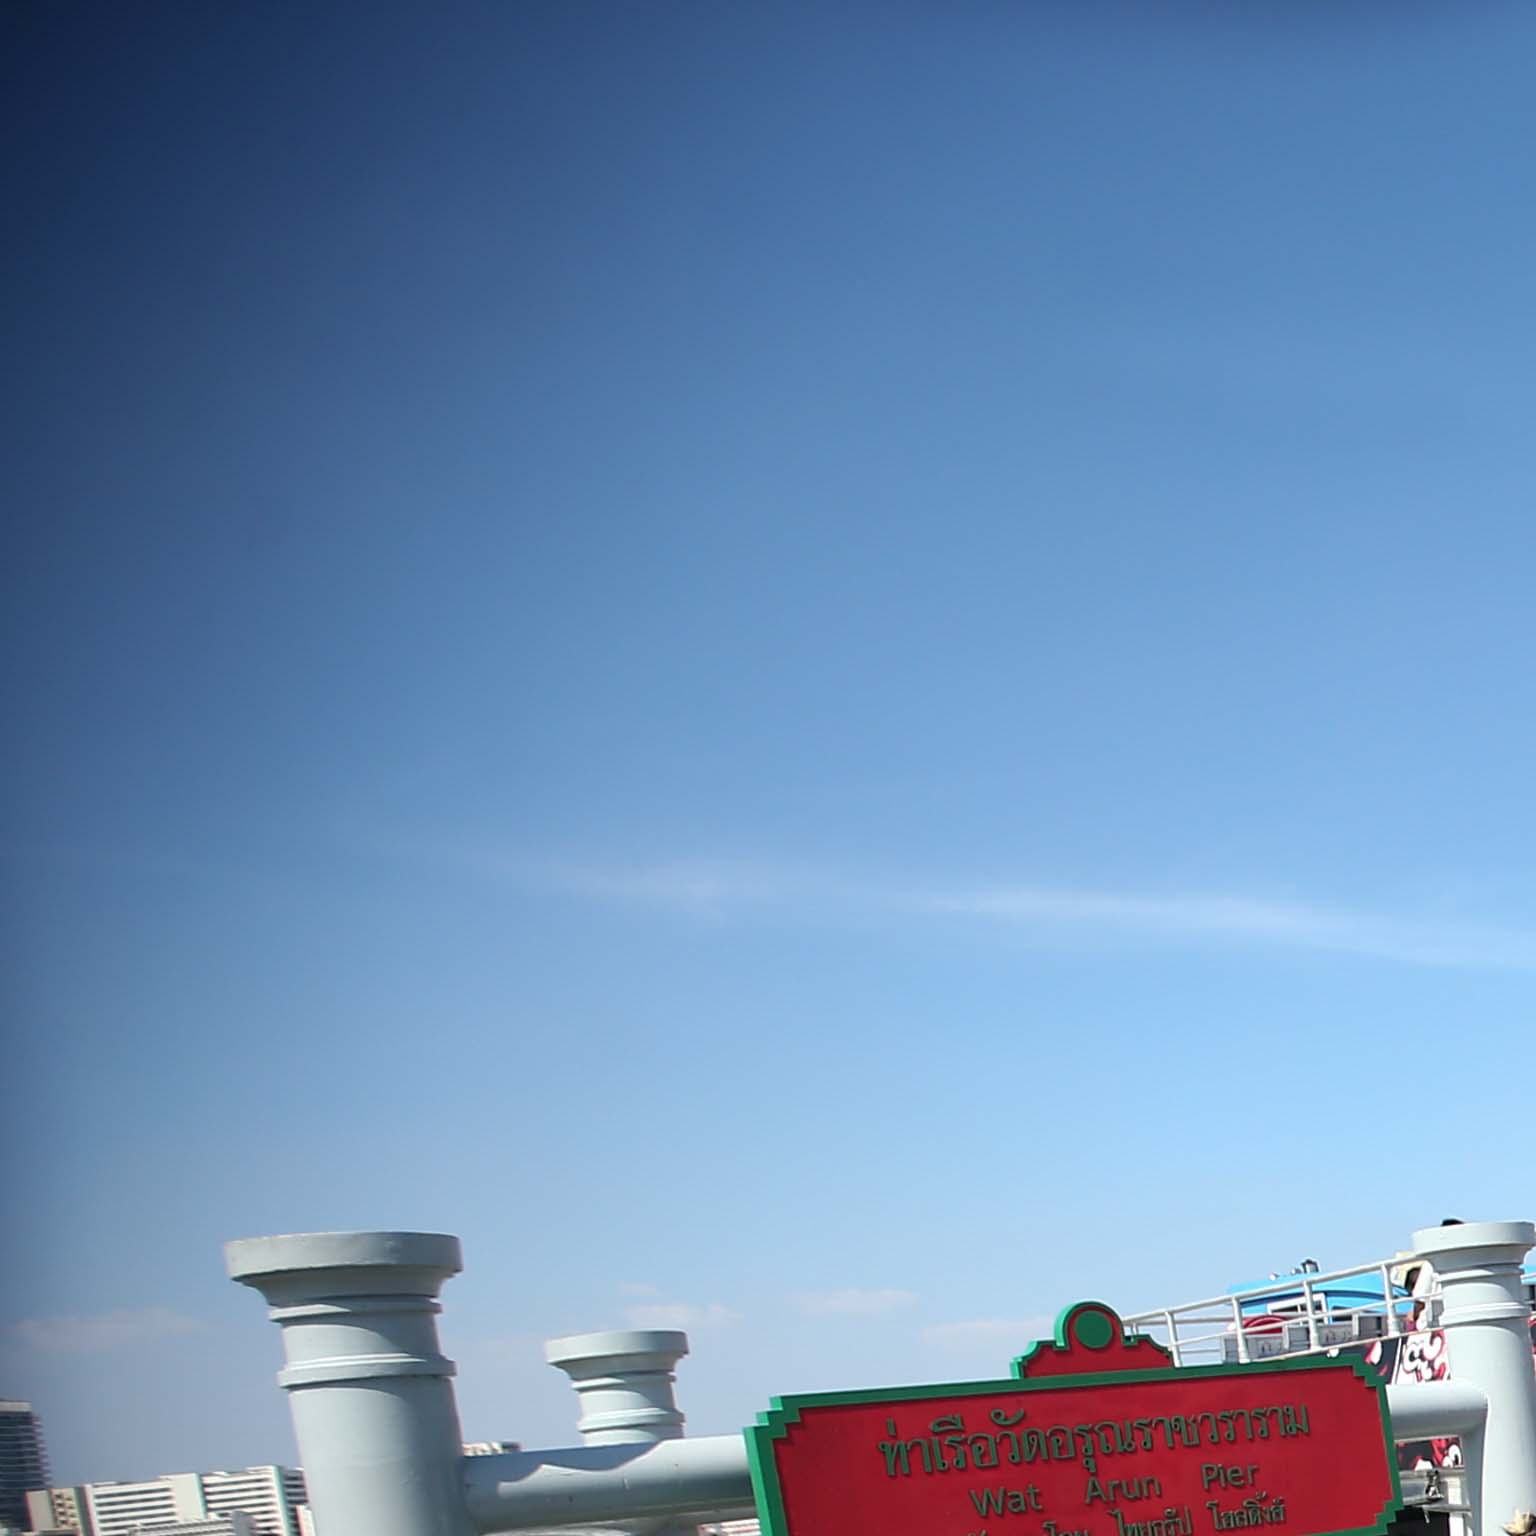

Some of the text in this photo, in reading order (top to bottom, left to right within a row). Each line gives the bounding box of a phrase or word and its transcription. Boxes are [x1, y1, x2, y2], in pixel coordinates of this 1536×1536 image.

[878, 1404, 1310, 1476] ท่าเรือวัดอรุณราชวราราม
[970, 1463, 1260, 1517] Wat Arun Pier
